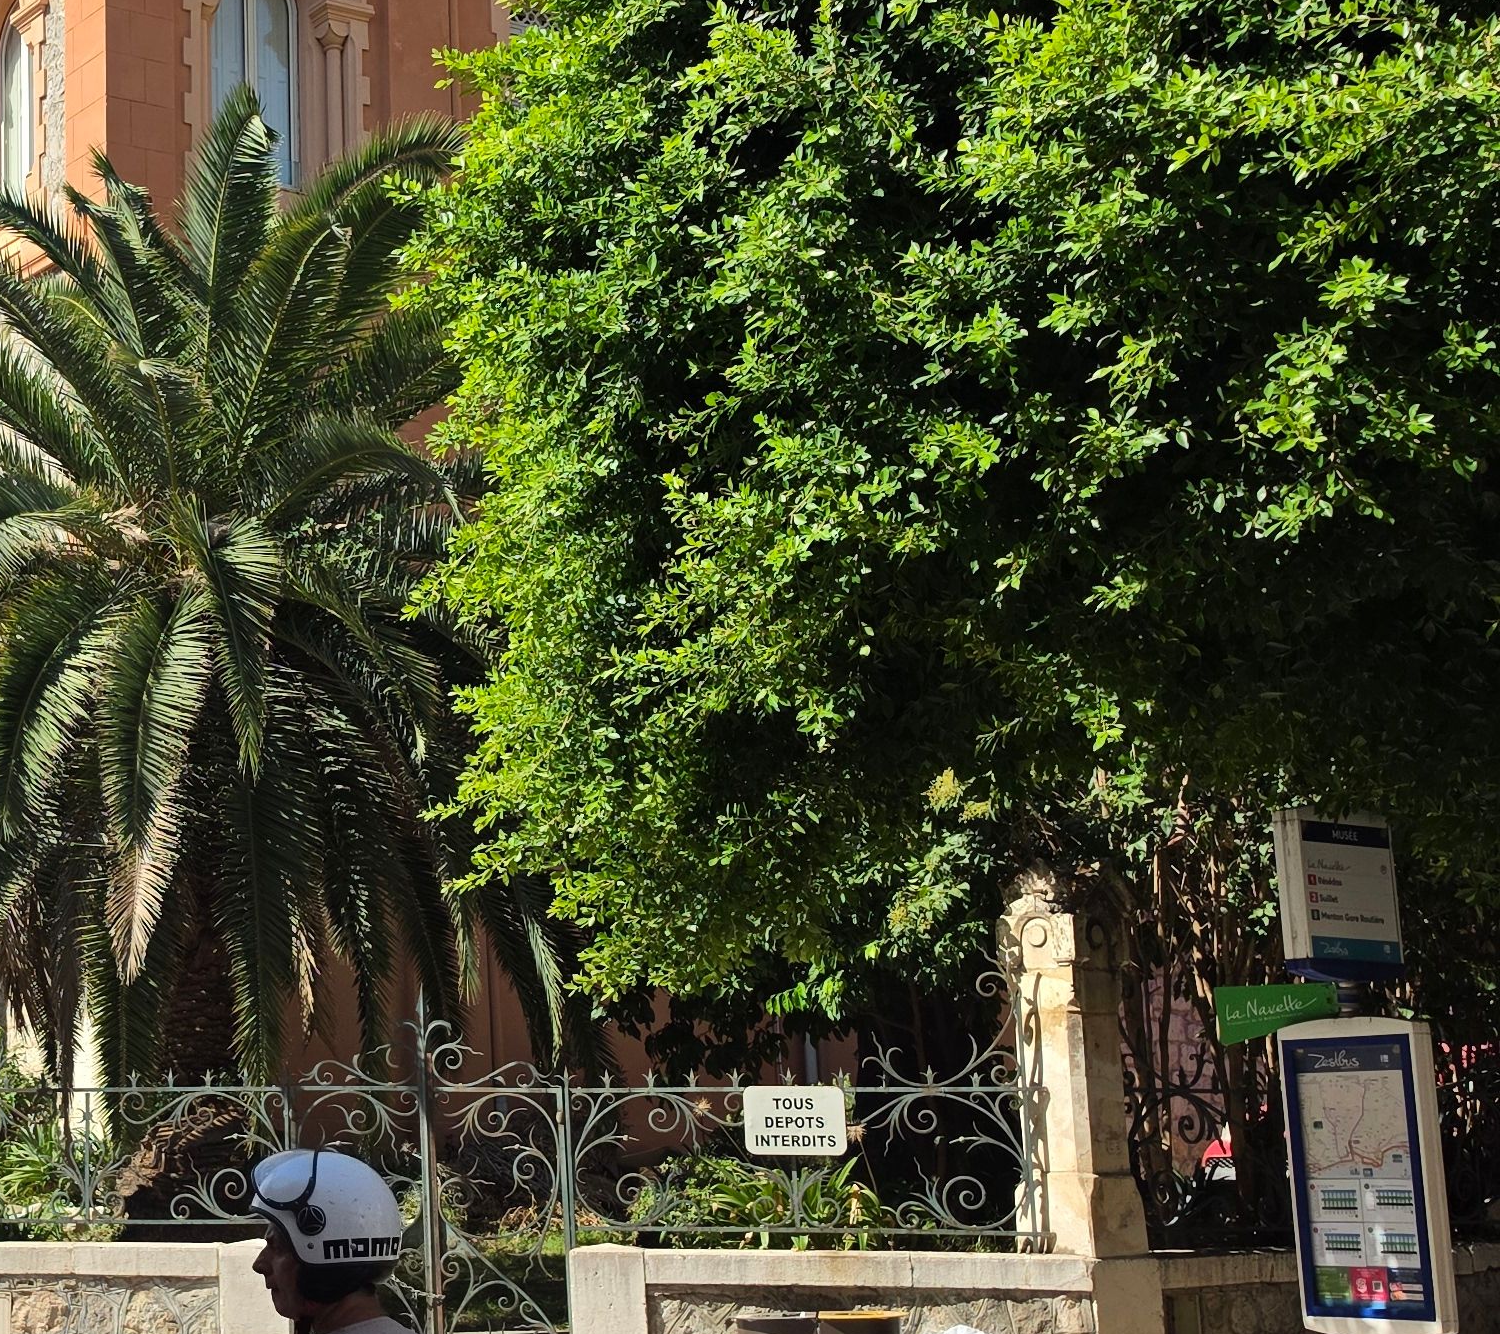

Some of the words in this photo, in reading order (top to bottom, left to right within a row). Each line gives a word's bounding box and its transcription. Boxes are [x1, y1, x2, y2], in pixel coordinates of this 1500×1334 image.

[1225, 1004, 1246, 1021] La
[1246, 994, 1317, 1019] Navette
[772, 1097, 814, 1110] TOUS
[765, 1116, 825, 1129] DEPOTS
[755, 1134, 837, 1148] INTERDITS
[322, 1236, 400, 1260] momo
